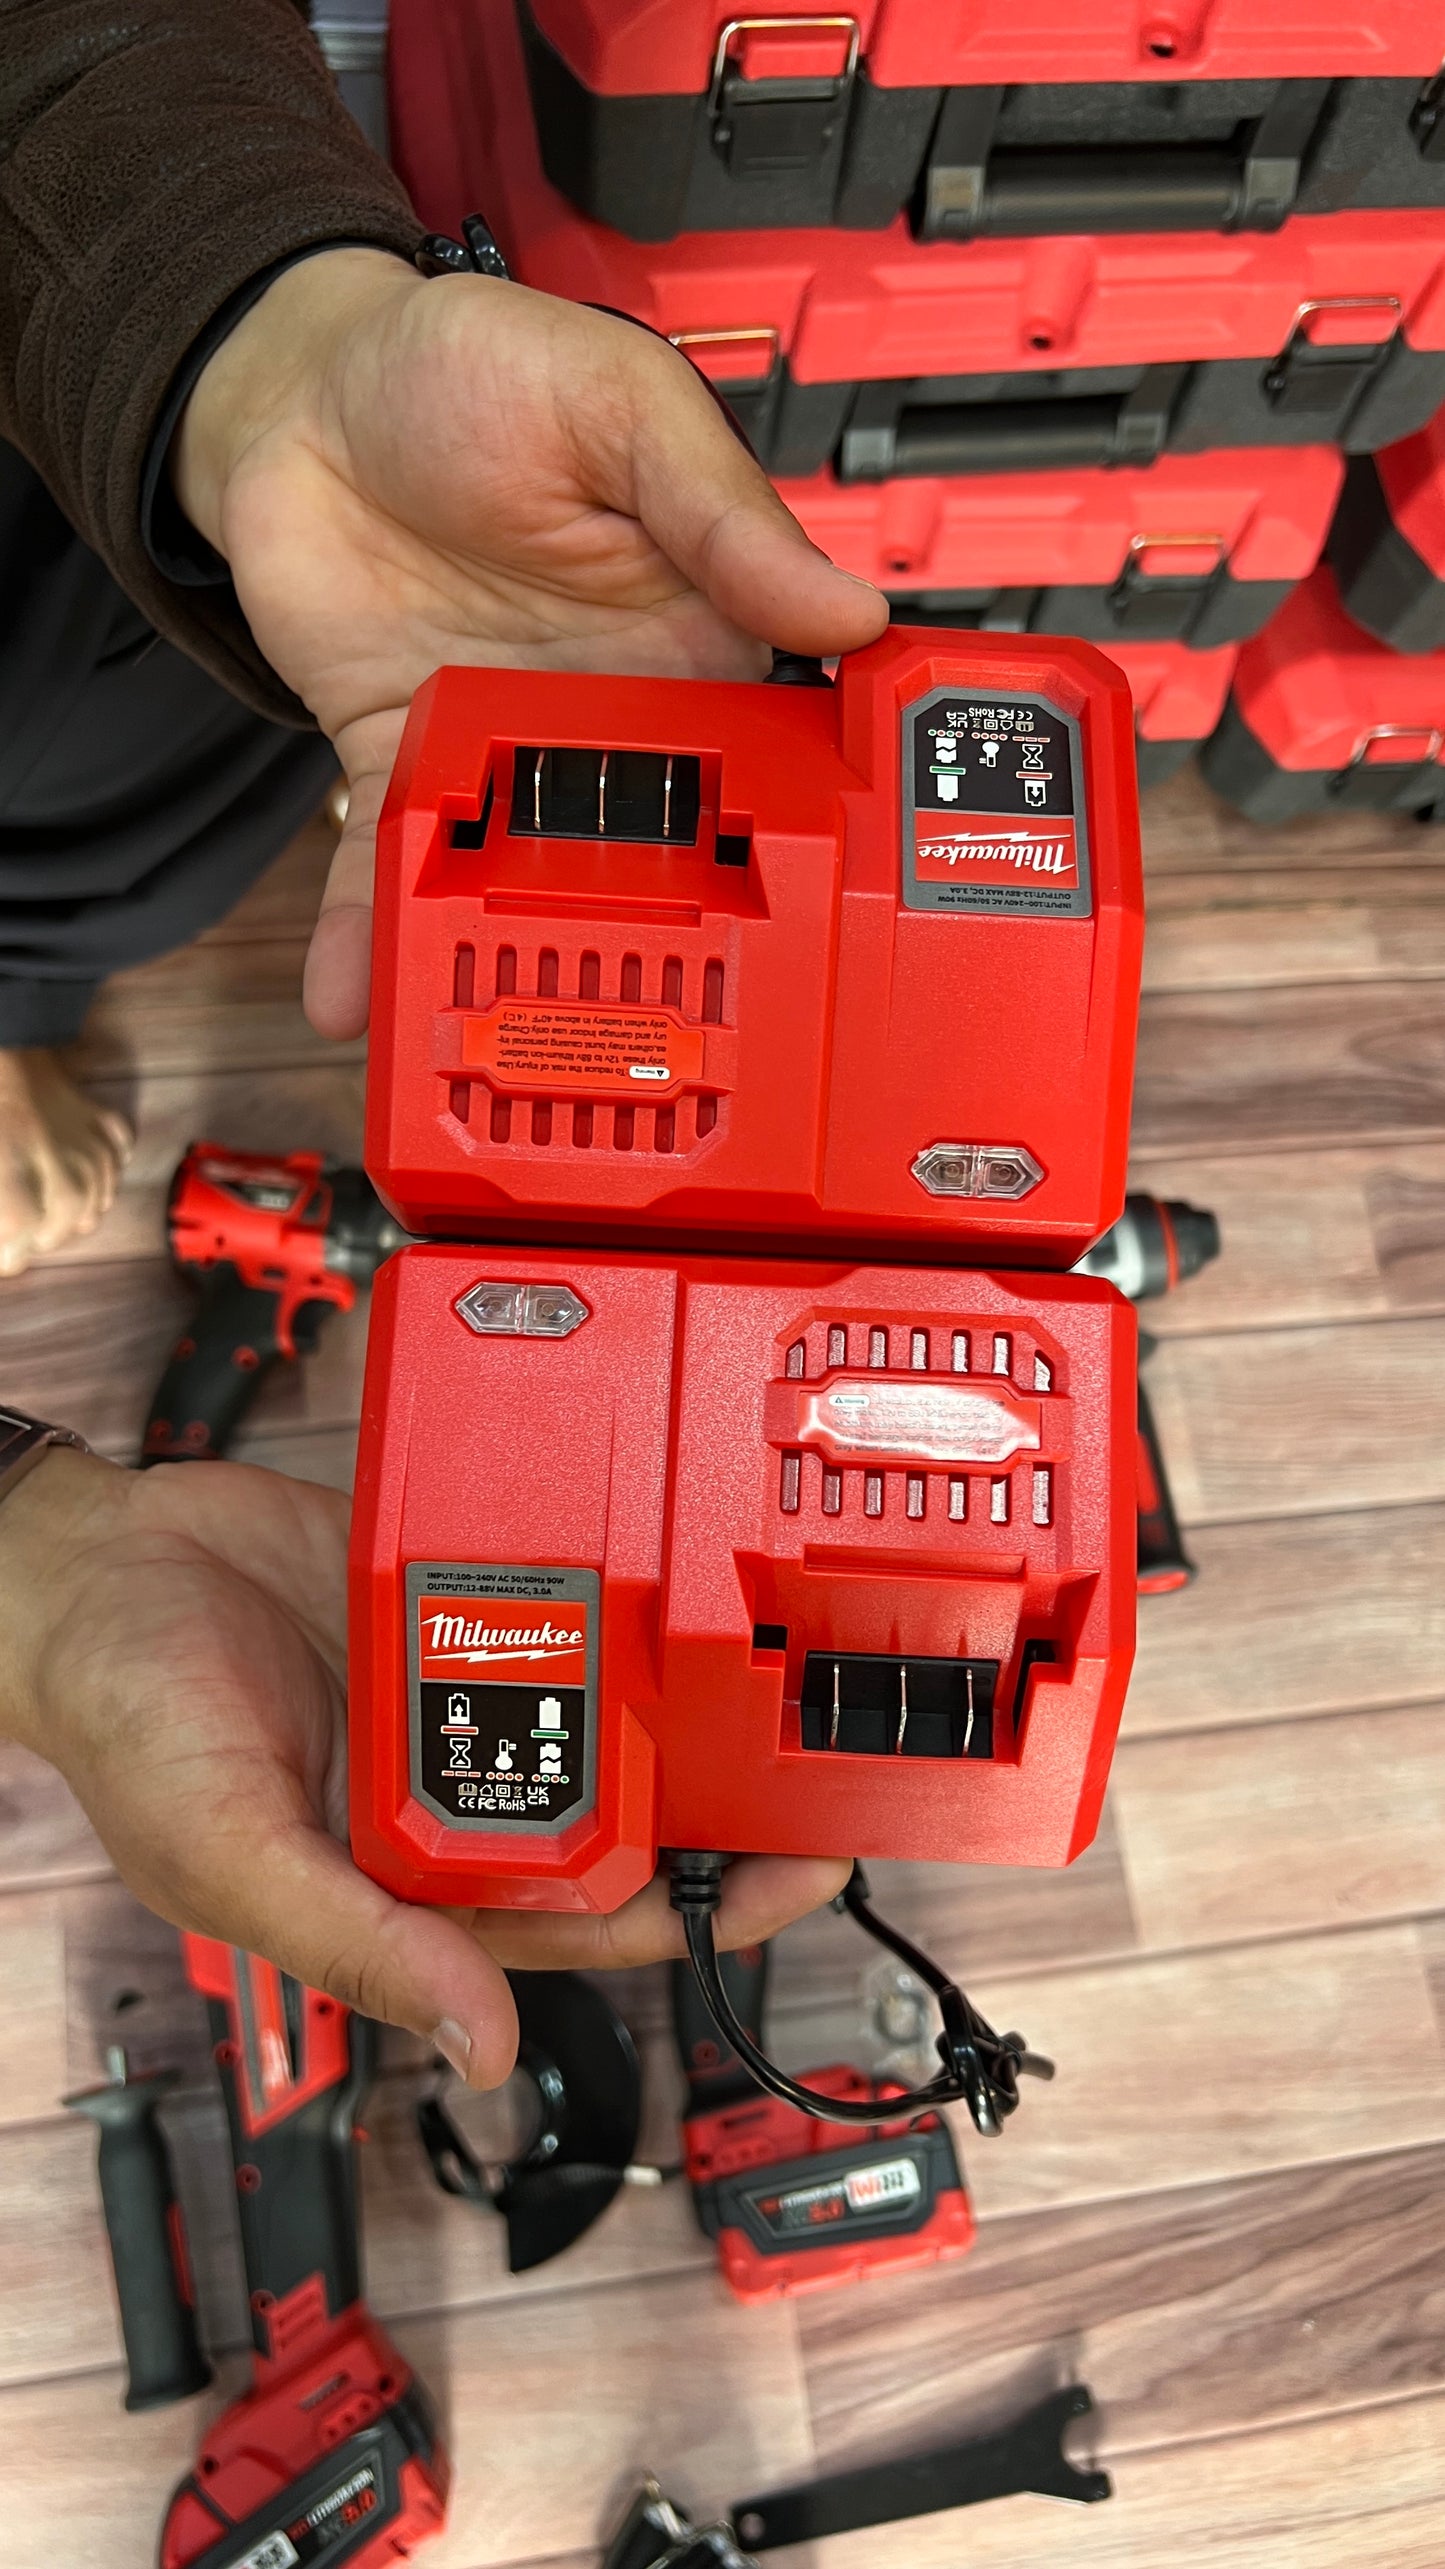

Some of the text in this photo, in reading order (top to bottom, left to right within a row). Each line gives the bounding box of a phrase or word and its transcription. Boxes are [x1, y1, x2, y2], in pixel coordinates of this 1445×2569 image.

[969, 708, 994, 718] RoHS
[947, 720, 968, 728] UK
[917, 844, 1075, 874] Milwaukee
[970, 887, 984, 895] DC,
[555, 1016, 580, 1024] above
[593, 1017, 622, 1026] battery
[650, 1020, 667, 1029] only
[599, 1030, 632, 1039] damage
[654, 1032, 667, 1040] ury
[512, 1038, 548, 1046] personal
[550, 1039, 582, 1048] causing
[585, 1042, 606, 1050] burst
[608, 1042, 626, 1050] may
[648, 1056, 665, 1064] only
[552, 1064, 566, 1072] risk
[511, 1575, 544, 1584] 50/60Hz
[517, 1587, 531, 1595] DC,
[421, 1612, 584, 1648] Milwaukee
[527, 1786, 549, 1796] UK
[499, 1799, 525, 1811] RoHS
[527, 1796, 549, 1805] CA
